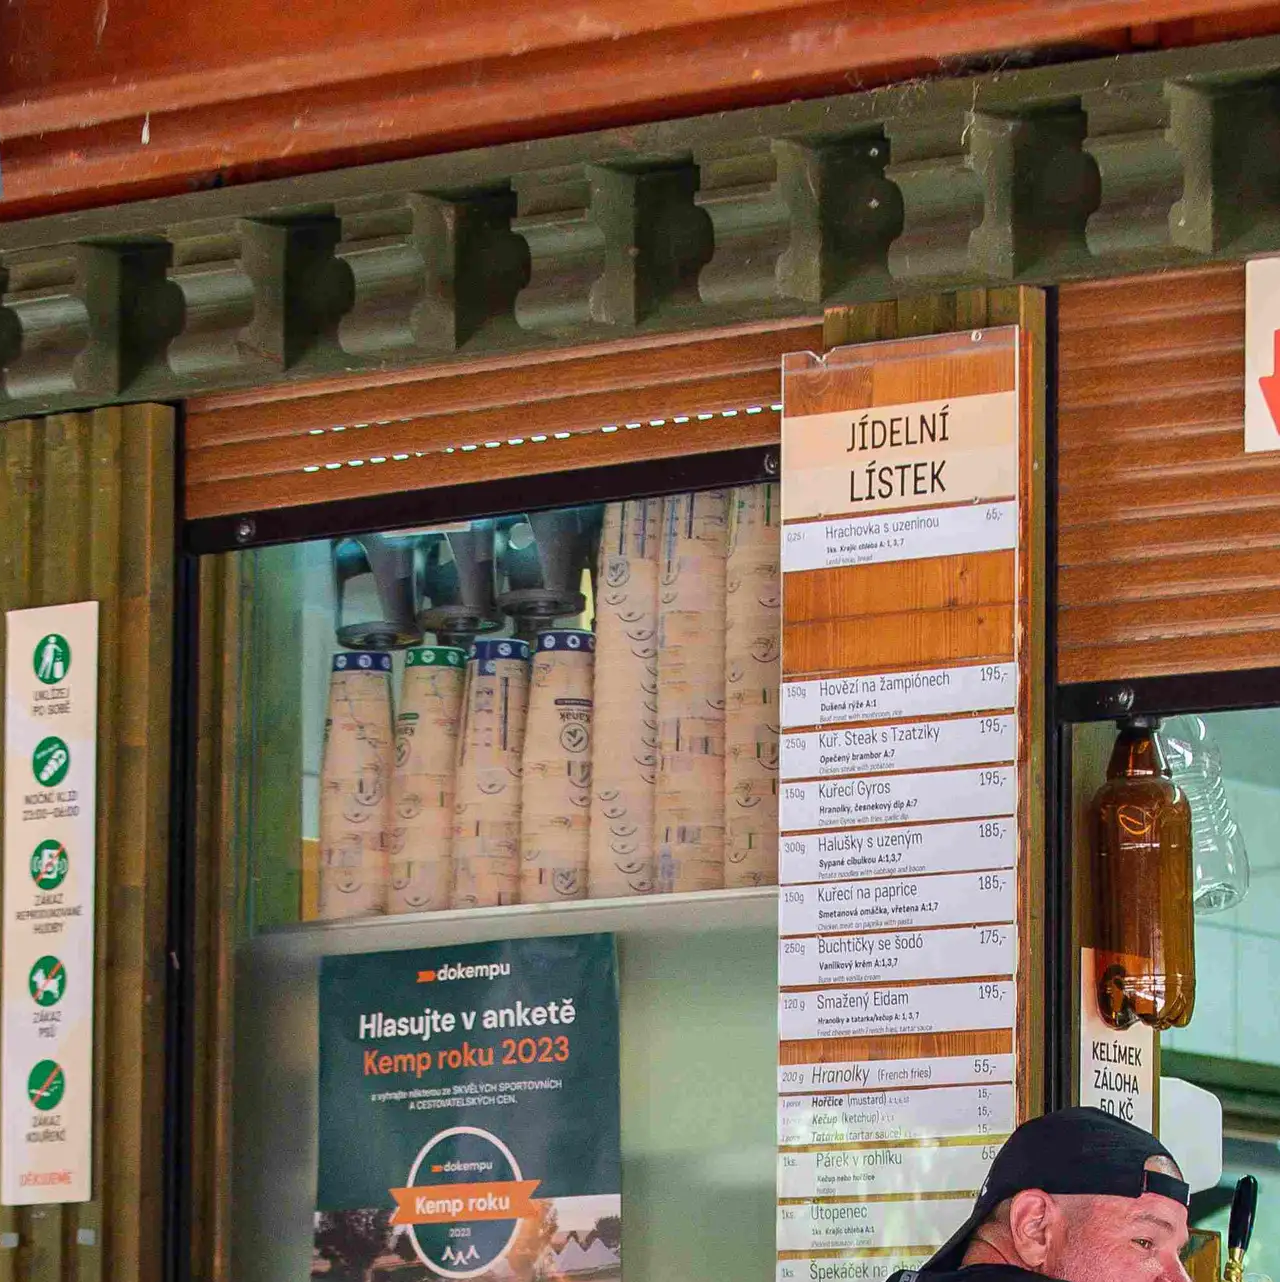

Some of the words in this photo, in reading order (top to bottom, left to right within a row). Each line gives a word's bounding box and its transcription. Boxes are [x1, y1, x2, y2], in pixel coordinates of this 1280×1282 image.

[846, 405, 950, 453] JÍDELNÍ
[850, 458, 947, 502] LÍSTEK
[985, 507, 1004, 524] 65,-
[825, 521, 880, 539] Hrachovka
[884, 524, 889, 533] s
[892, 517, 939, 532] uzeninou
[787, 687, 806, 698] 150g
[820, 678, 859, 696] Hovězí
[862, 681, 876, 693] na
[880, 672, 950, 692] žampiónech
[980, 667, 1008, 682] 195,-
[821, 701, 846, 712] Dušená
[848, 701, 864, 711] rýže
[786, 738, 806, 751] 250g
[819, 731, 841, 748] Kuř.
[845, 730, 878, 746] Steak
[881, 732, 888, 742] s
[891, 725, 940, 743] Tzatziky
[980, 719, 1007, 735] 195,-
[820, 754, 850, 764] Opečený
[852, 751, 882, 761] brambor
[884, 749, 895, 759] A:7
[785, 789, 805, 800] 150g
[818, 782, 855, 798] Kuřecí
[857, 781, 891, 798] Gyros
[979, 771, 1007, 787] 195,-
[820, 805, 853, 815] Hranolky,
[855, 802, 892, 812] česnekový
[893, 800, 904, 810] dip
[905, 799, 918, 808] A:7
[784, 841, 805, 854] 300g
[818, 836, 862, 852] Halušky
[867, 838, 873, 848] s
[877, 831, 923, 848] uzeným
[979, 823, 1007, 839] 185,-
[819, 858, 845, 869] Sypané
[847, 856, 876, 866] cibulkou
[784, 891, 804, 904] 150g
[818, 887, 854, 903] Kuřecí
[857, 888, 871, 899] na
[875, 884, 917, 901] paprice
[979, 875, 1007, 891] 185,-
[819, 908, 858, 919] Smetanová
[860, 906, 889, 917] omáčka,
[891, 905, 919, 915] vřetena
[921, 902, 939, 912] A:1,7
[785, 943, 805, 955] 250g
[818, 938, 874, 955] Buchtičky
[878, 941, 891, 950] se
[895, 934, 923, 949] šodó
[980, 929, 1007, 945] 175,-
[437, 962, 510, 982] dokempu
[819, 959, 853, 971] Vanilkový
[855, 960, 873, 969] krém
[784, 999, 799, 1009] 120
[817, 993, 868, 1010] Smažený
[873, 991, 909, 1007] Eidam
[978, 985, 1007, 1001] 195,-
[359, 1007, 455, 1041] Hlasujte
[461, 1012, 476, 1030] v
[483, 998, 576, 1029] anketě
[818, 1015, 845, 1025] Hranolky
[851, 1013, 893, 1023] tatarka/kečup
[364, 1049, 431, 1078] Kemp
[438, 1042, 493, 1069] roku
[502, 1036, 570, 1065] 2023
[1091, 1039, 1142, 1067] KELÍMEK
[782, 1072, 797, 1083] 200
[812, 1064, 870, 1085] Hranolky
[878, 1069, 909, 1081] (French
[911, 1066, 932, 1079] fries)
[974, 1059, 997, 1075] 55,-
[1093, 1067, 1140, 1096] ZÁLOHA
[452, 1082, 496, 1094] SKVĚLÝCH
[499, 1078, 562, 1093] SPORTOVNÍCH
[497, 1095, 517, 1105] CEN.
[812, 1097, 843, 1107] Hořčice
[847, 1093, 886, 1106] (mustard)
[978, 1089, 992, 1100] 15,-
[812, 1114, 838, 1125] Kečup
[842, 1111, 879, 1124] (ketchup)
[978, 1106, 992, 1118] 15,-
[1100, 1098, 1115, 1116] 50
[1119, 1095, 1135, 1122] KČ
[846, 1130, 873, 1140] (tartar
[875, 1127, 902, 1139] sauce)
[443, 1160, 493, 1173] dokempu
[784, 1157, 797, 1166] 1ks.
[816, 1153, 849, 1168] Párek
[853, 1156, 858, 1166] v
[863, 1150, 902, 1165] rohlíku
[416, 1195, 464, 1217] Kemp
[468, 1193, 510, 1211] roku
[811, 1206, 868, 1223] Utopenec
[873, 1265, 888, 1278] na
